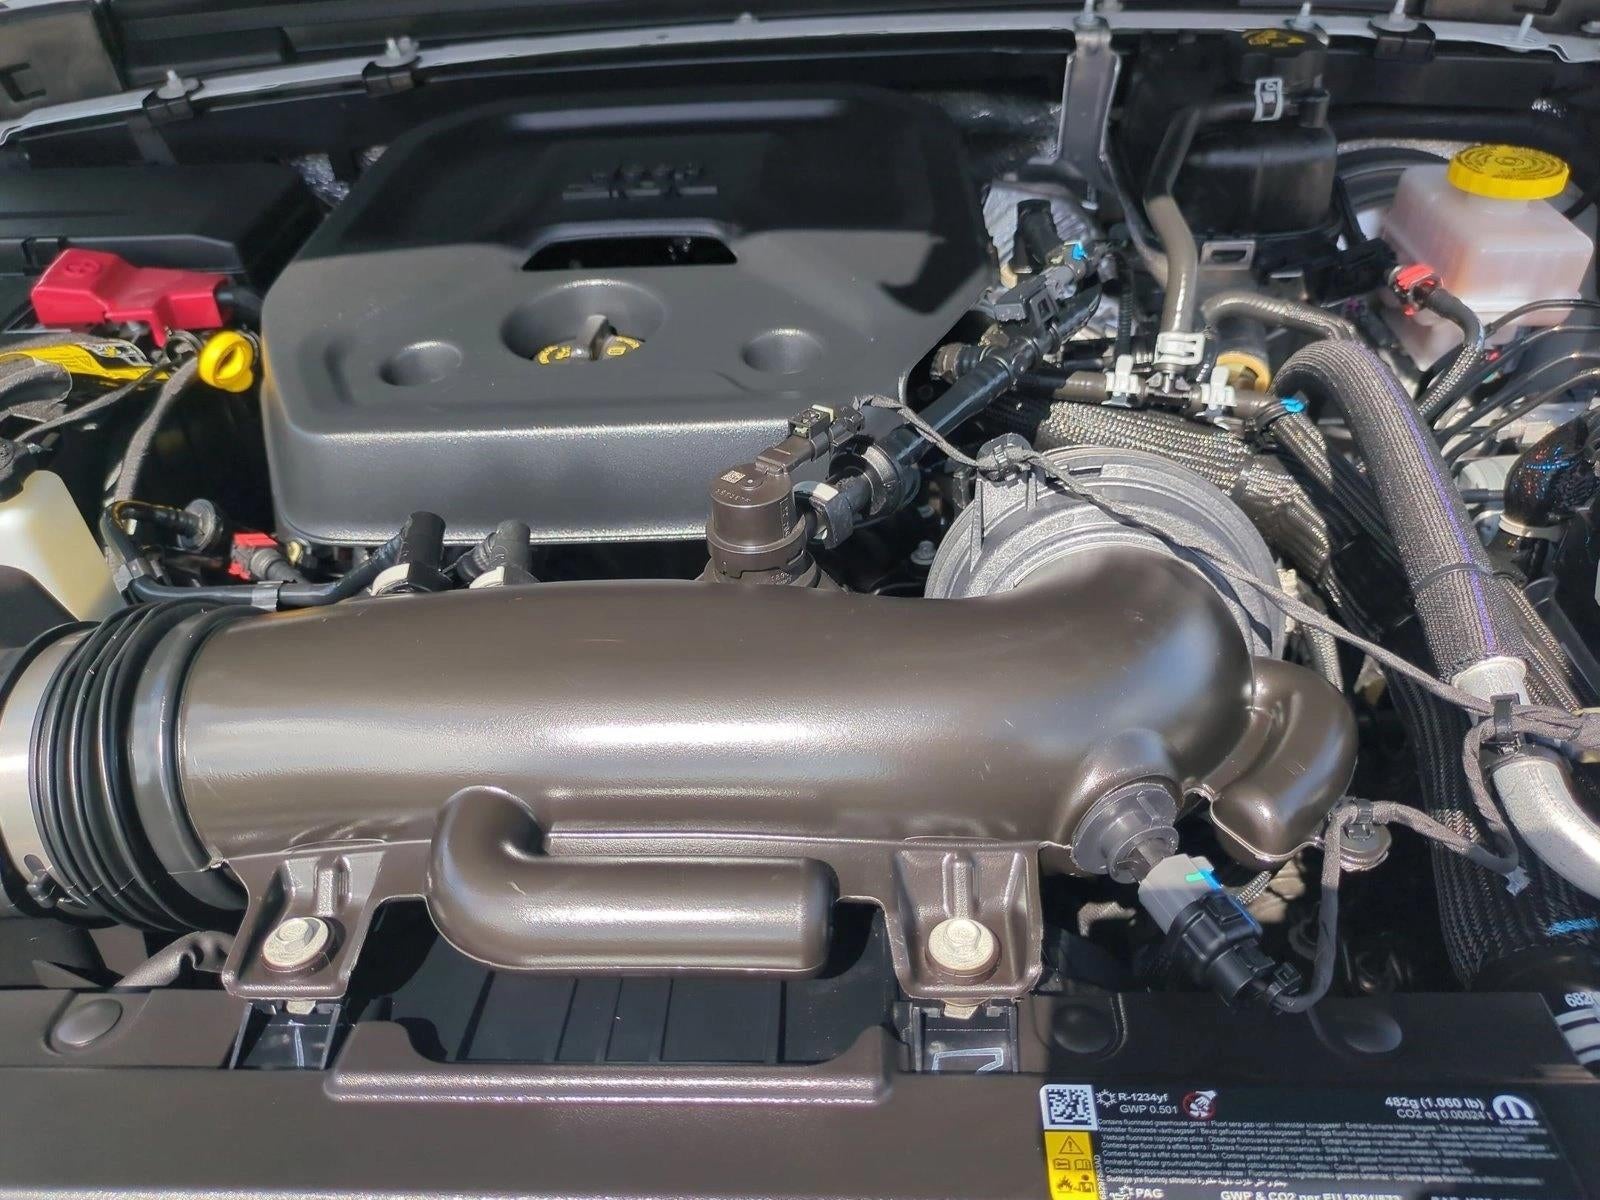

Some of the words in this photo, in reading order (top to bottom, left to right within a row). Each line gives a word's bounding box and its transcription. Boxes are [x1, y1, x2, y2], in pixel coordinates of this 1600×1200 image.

[1118, 1093, 1168, 1104] R-1234yf
[1385, 1096, 1419, 1109] 482g
[1463, 1098, 1485, 1111] lb)
[1119, 1104, 1147, 1114] GWP
[1149, 1105, 1178, 1114] 0.501
[1396, 1108, 1422, 1119] CO2
[1424, 1110, 1440, 1120] eq
[1135, 1188, 1164, 1199] PAG
[1220, 1191, 1253, 1200] GWP
